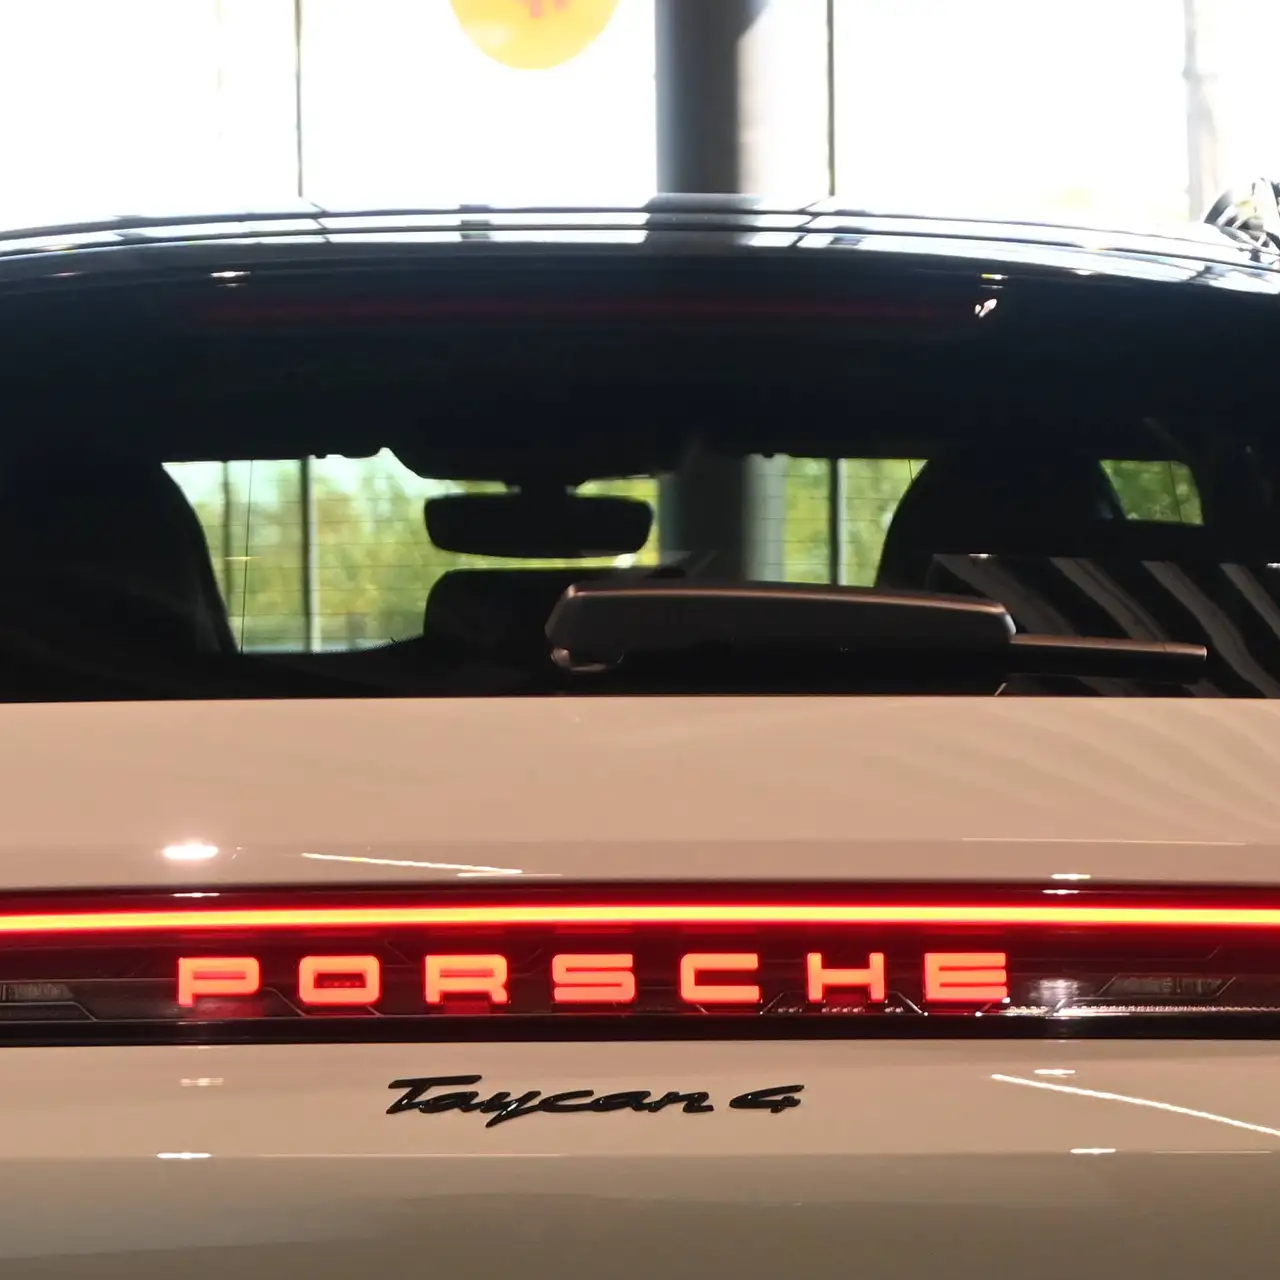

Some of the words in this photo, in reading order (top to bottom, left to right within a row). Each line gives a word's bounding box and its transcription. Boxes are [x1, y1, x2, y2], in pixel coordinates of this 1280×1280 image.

[177, 952, 1009, 1005] PORSCHE
[386, 1074, 715, 1127] Taycan
[729, 1084, 806, 1115] 4
